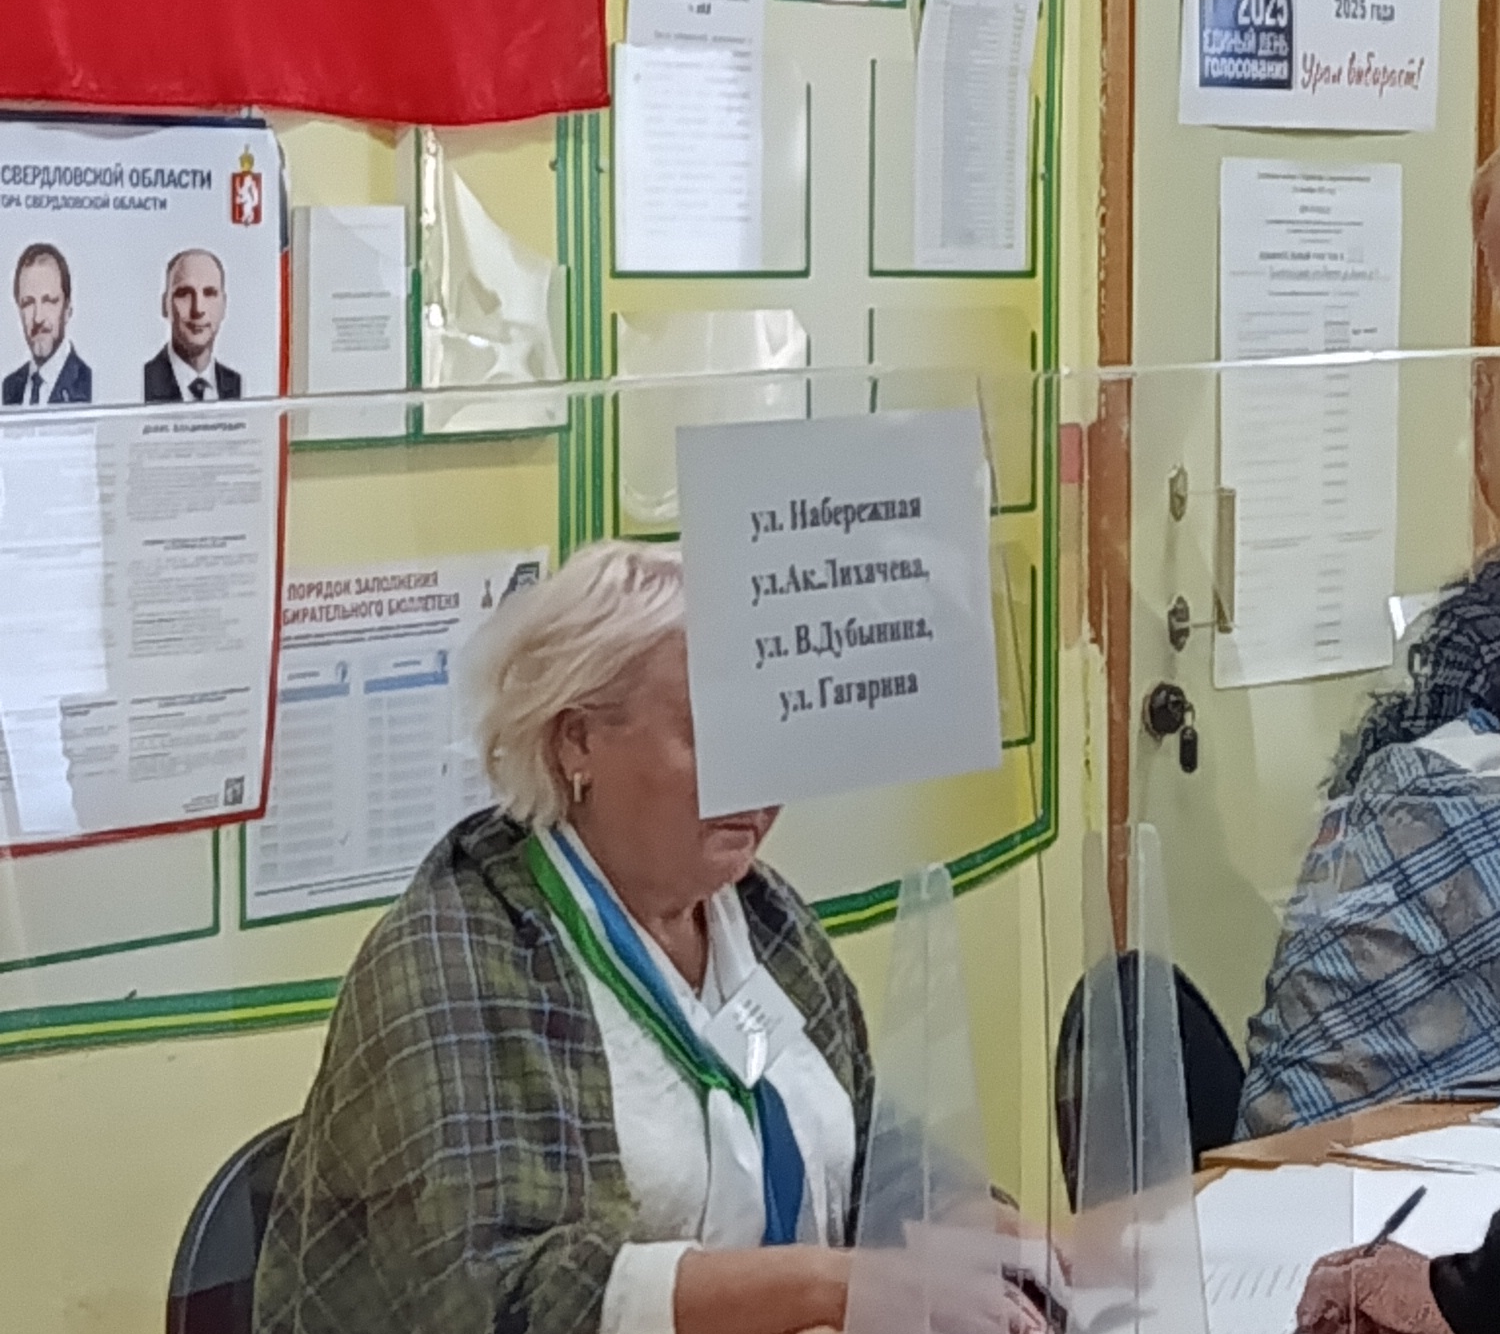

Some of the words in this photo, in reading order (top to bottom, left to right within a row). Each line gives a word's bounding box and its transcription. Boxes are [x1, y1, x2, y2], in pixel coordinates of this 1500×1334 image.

[1371, 3, 1396, 24] года
[1203, 27, 1257, 55] ЕДИНЫЙ
[1258, 31, 1290, 57] ДЕНЬ
[1301, 52, 1343, 95] Урал
[1, 163, 124, 189] СВЕРДЛОВСКОЙ
[128, 168, 213, 190] ОБЛАСТИ
[25, 193, 110, 210] СВЕРДЛОВСКОЙ
[113, 196, 168, 211] ОБЛАСТИ
[751, 509, 784, 543] ул.
[789, 496, 922, 534] Набережная
[287, 580, 351, 602] ПОРЯДОК
[354, 570, 438, 596] ЗАПОЛНЕНИЯ
[388, 592, 460, 616] БЮЛЛЕТЕНЯ
[754, 634, 789, 669] ул.
[779, 688, 813, 722] ул.
[818, 671, 920, 709] Гагарина
